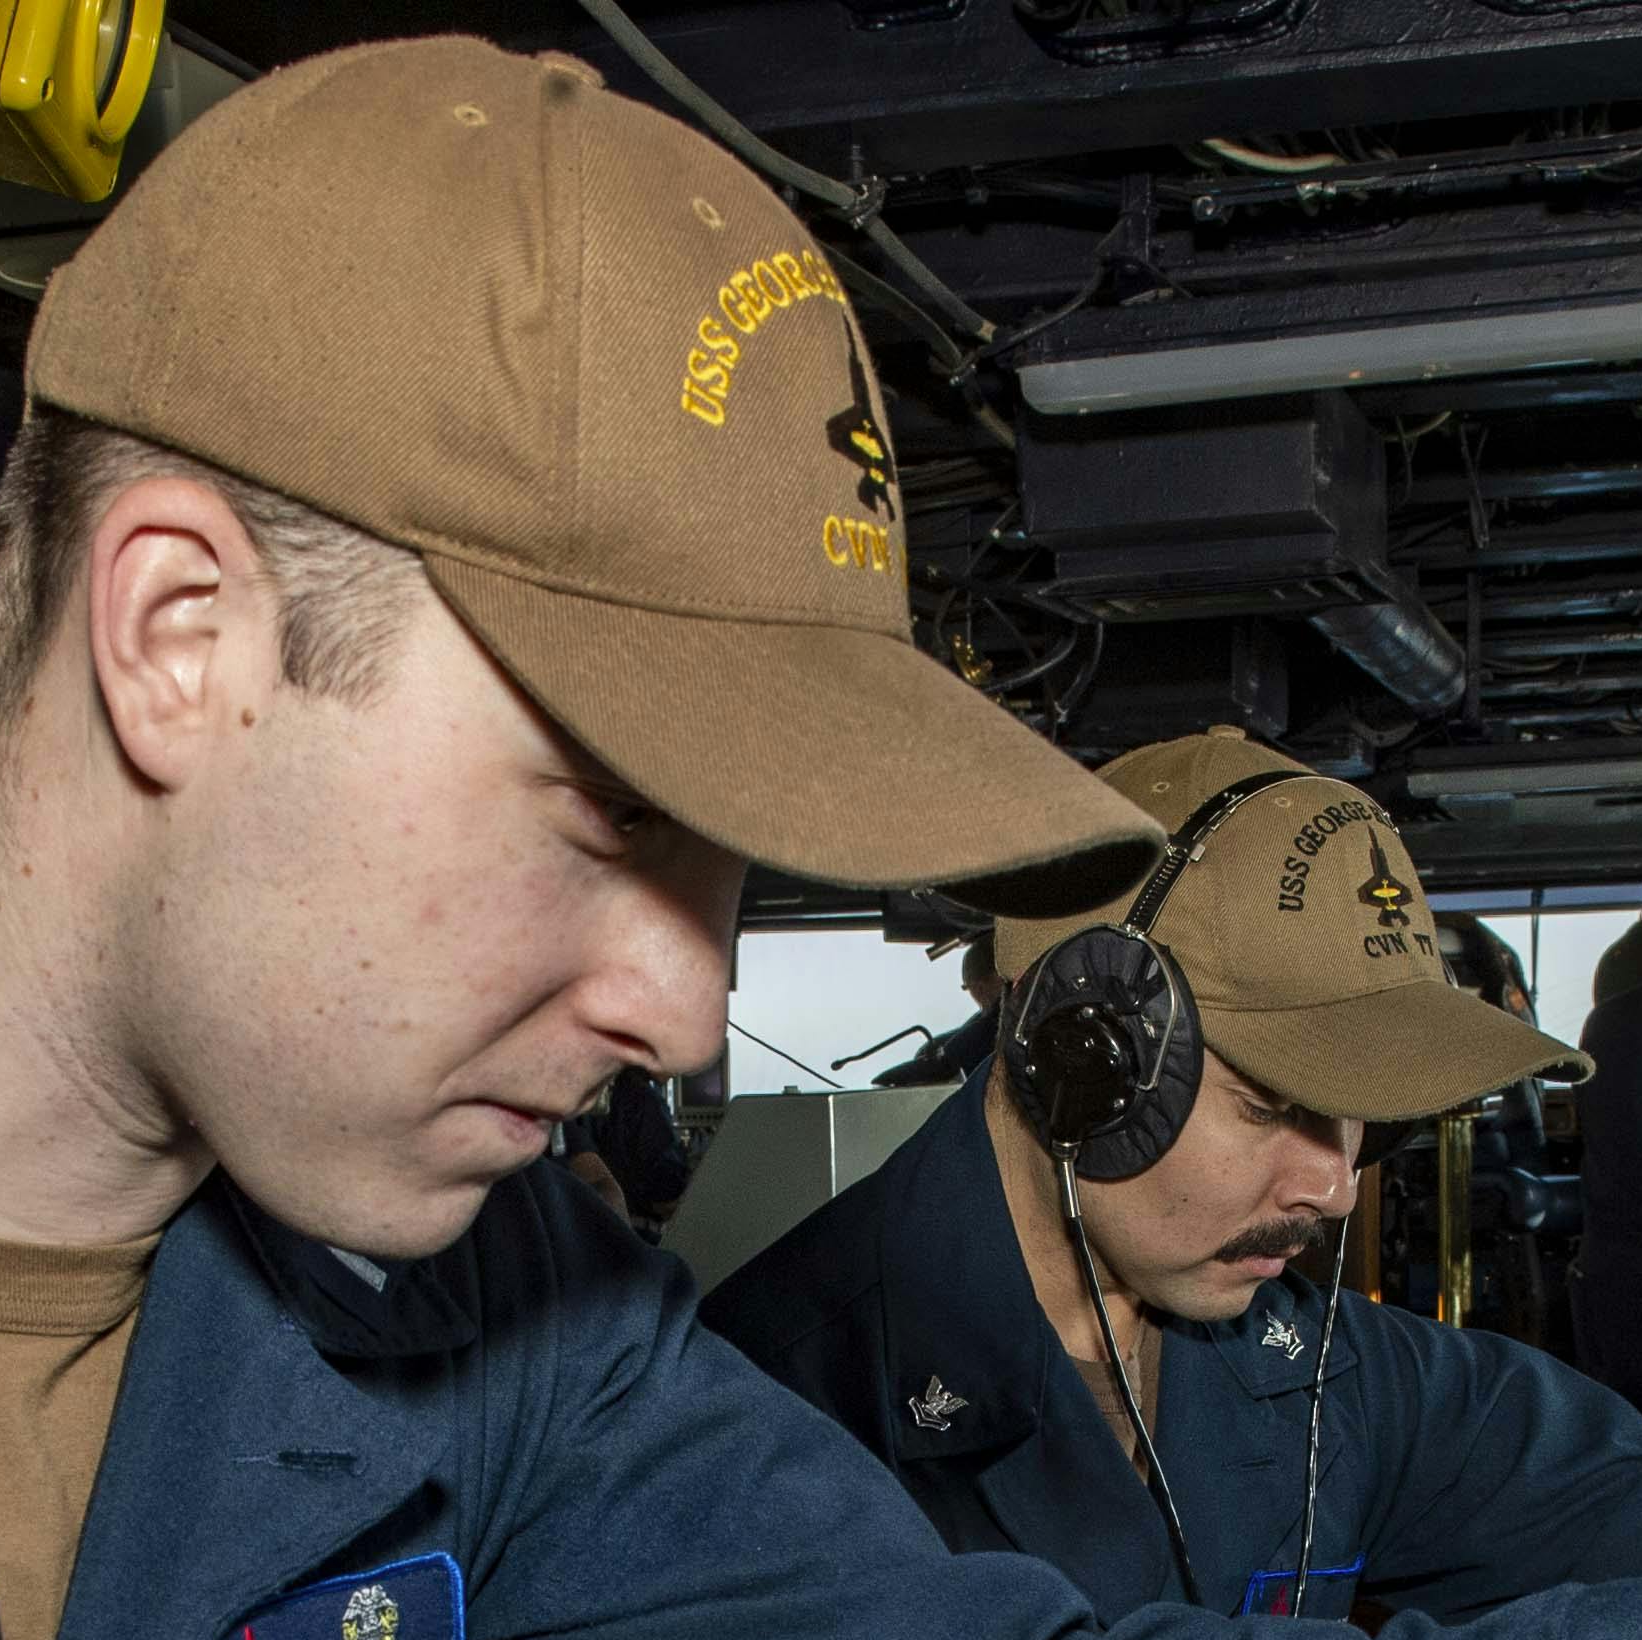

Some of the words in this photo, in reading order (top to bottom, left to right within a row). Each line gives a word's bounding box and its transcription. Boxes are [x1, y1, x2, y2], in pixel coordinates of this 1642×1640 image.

[680, 313, 742, 428] USS
[822, 515, 892, 576] CVN
[1293, 800, 1373, 857] GEORGE
[1278, 855, 1310, 912] USS
[1363, 931, 1409, 958] CVN
[1412, 933, 1435, 957] 77
